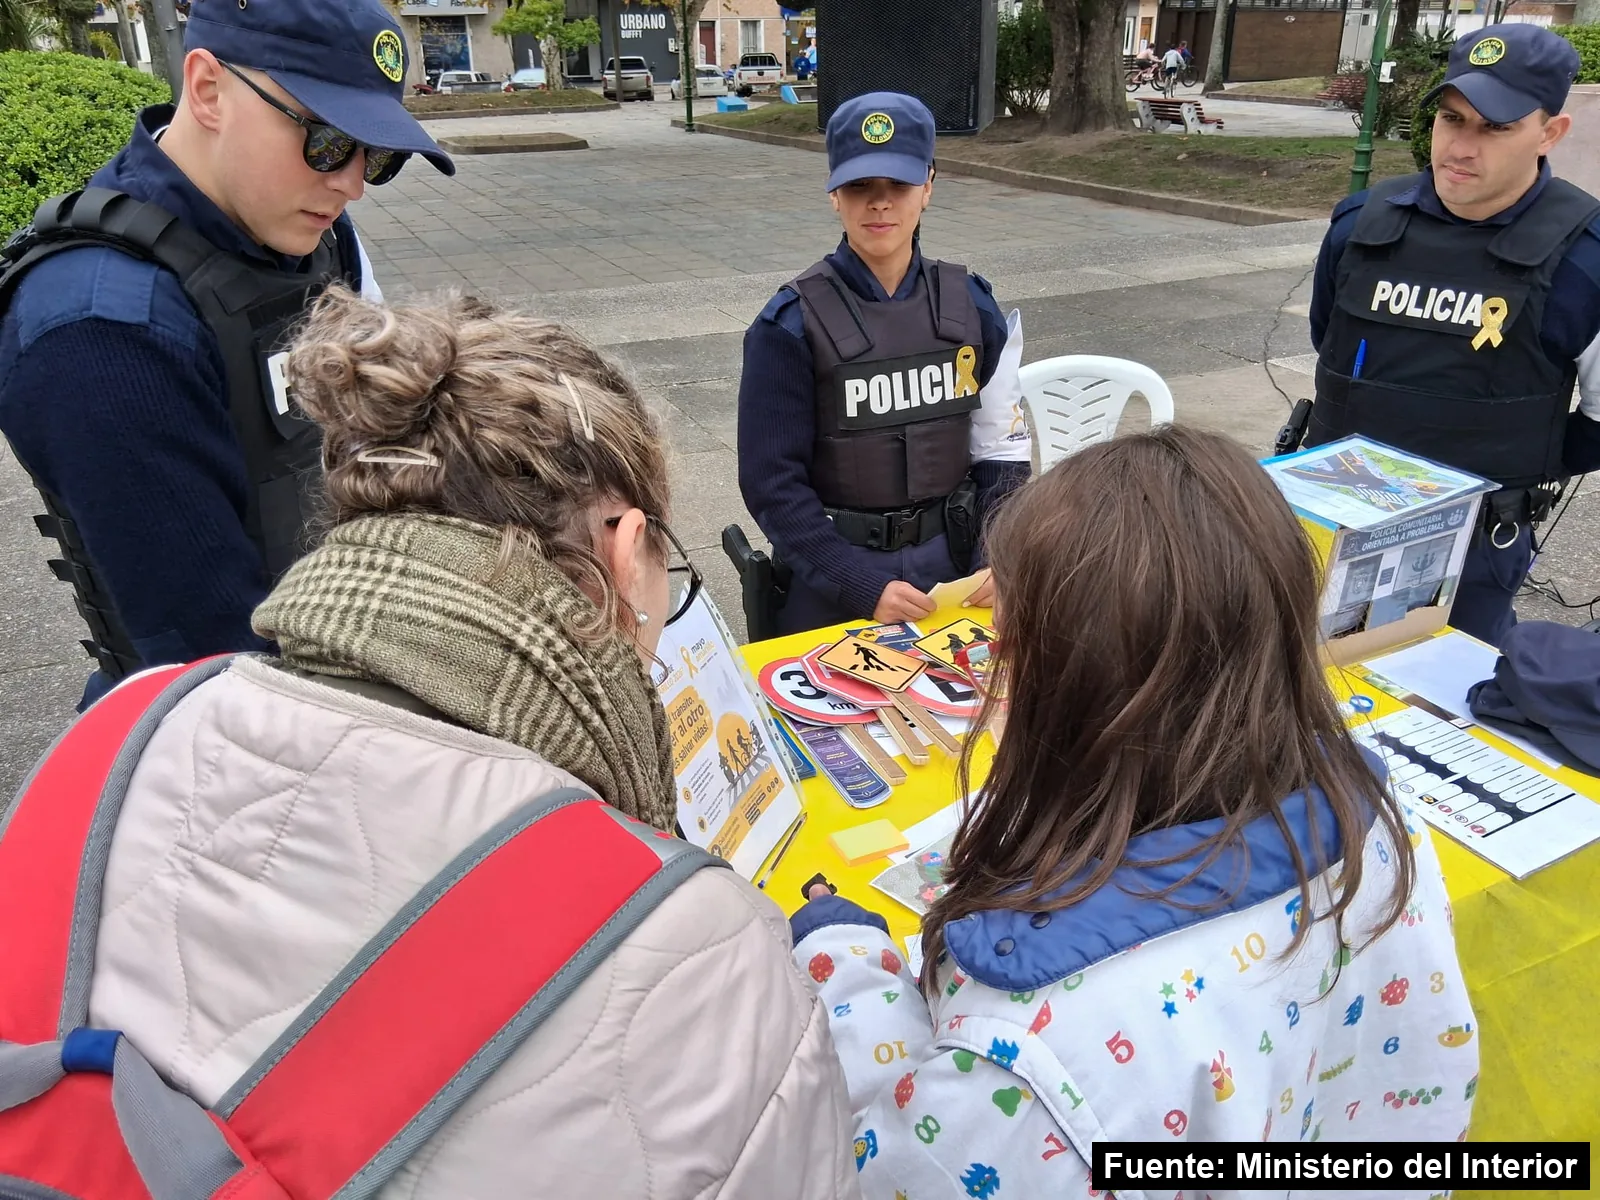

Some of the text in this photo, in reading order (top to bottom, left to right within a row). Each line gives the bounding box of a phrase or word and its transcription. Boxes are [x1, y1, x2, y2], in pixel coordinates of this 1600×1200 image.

[620, 13, 666, 29] URBANO
[1370, 280, 1484, 328] POLICIA
[1361, 535, 1399, 552] ORIENTADA
[1406, 521, 1445, 540] PROBLEMAS
[779, 670, 828, 700] 3
[677, 717, 688, 738] al
[686, 703, 705, 728] otro
[679, 740, 695, 762] salvar
[1229, 931, 1267, 974] 10
[1429, 971, 1445, 994] 3
[1286, 1001, 1300, 1031] 2
[1105, 1030, 1135, 1065] 5
[1258, 1030, 1274, 1056] 4
[1382, 1036, 1400, 1056] 6
[1060, 1081, 1085, 1111] 1
[1279, 1087, 1294, 1115] 3
[1344, 1100, 1361, 1121] 7
[914, 1114, 941, 1145] 8
[1163, 1108, 1189, 1137] 9
[1041, 1132, 1068, 1161] 7
